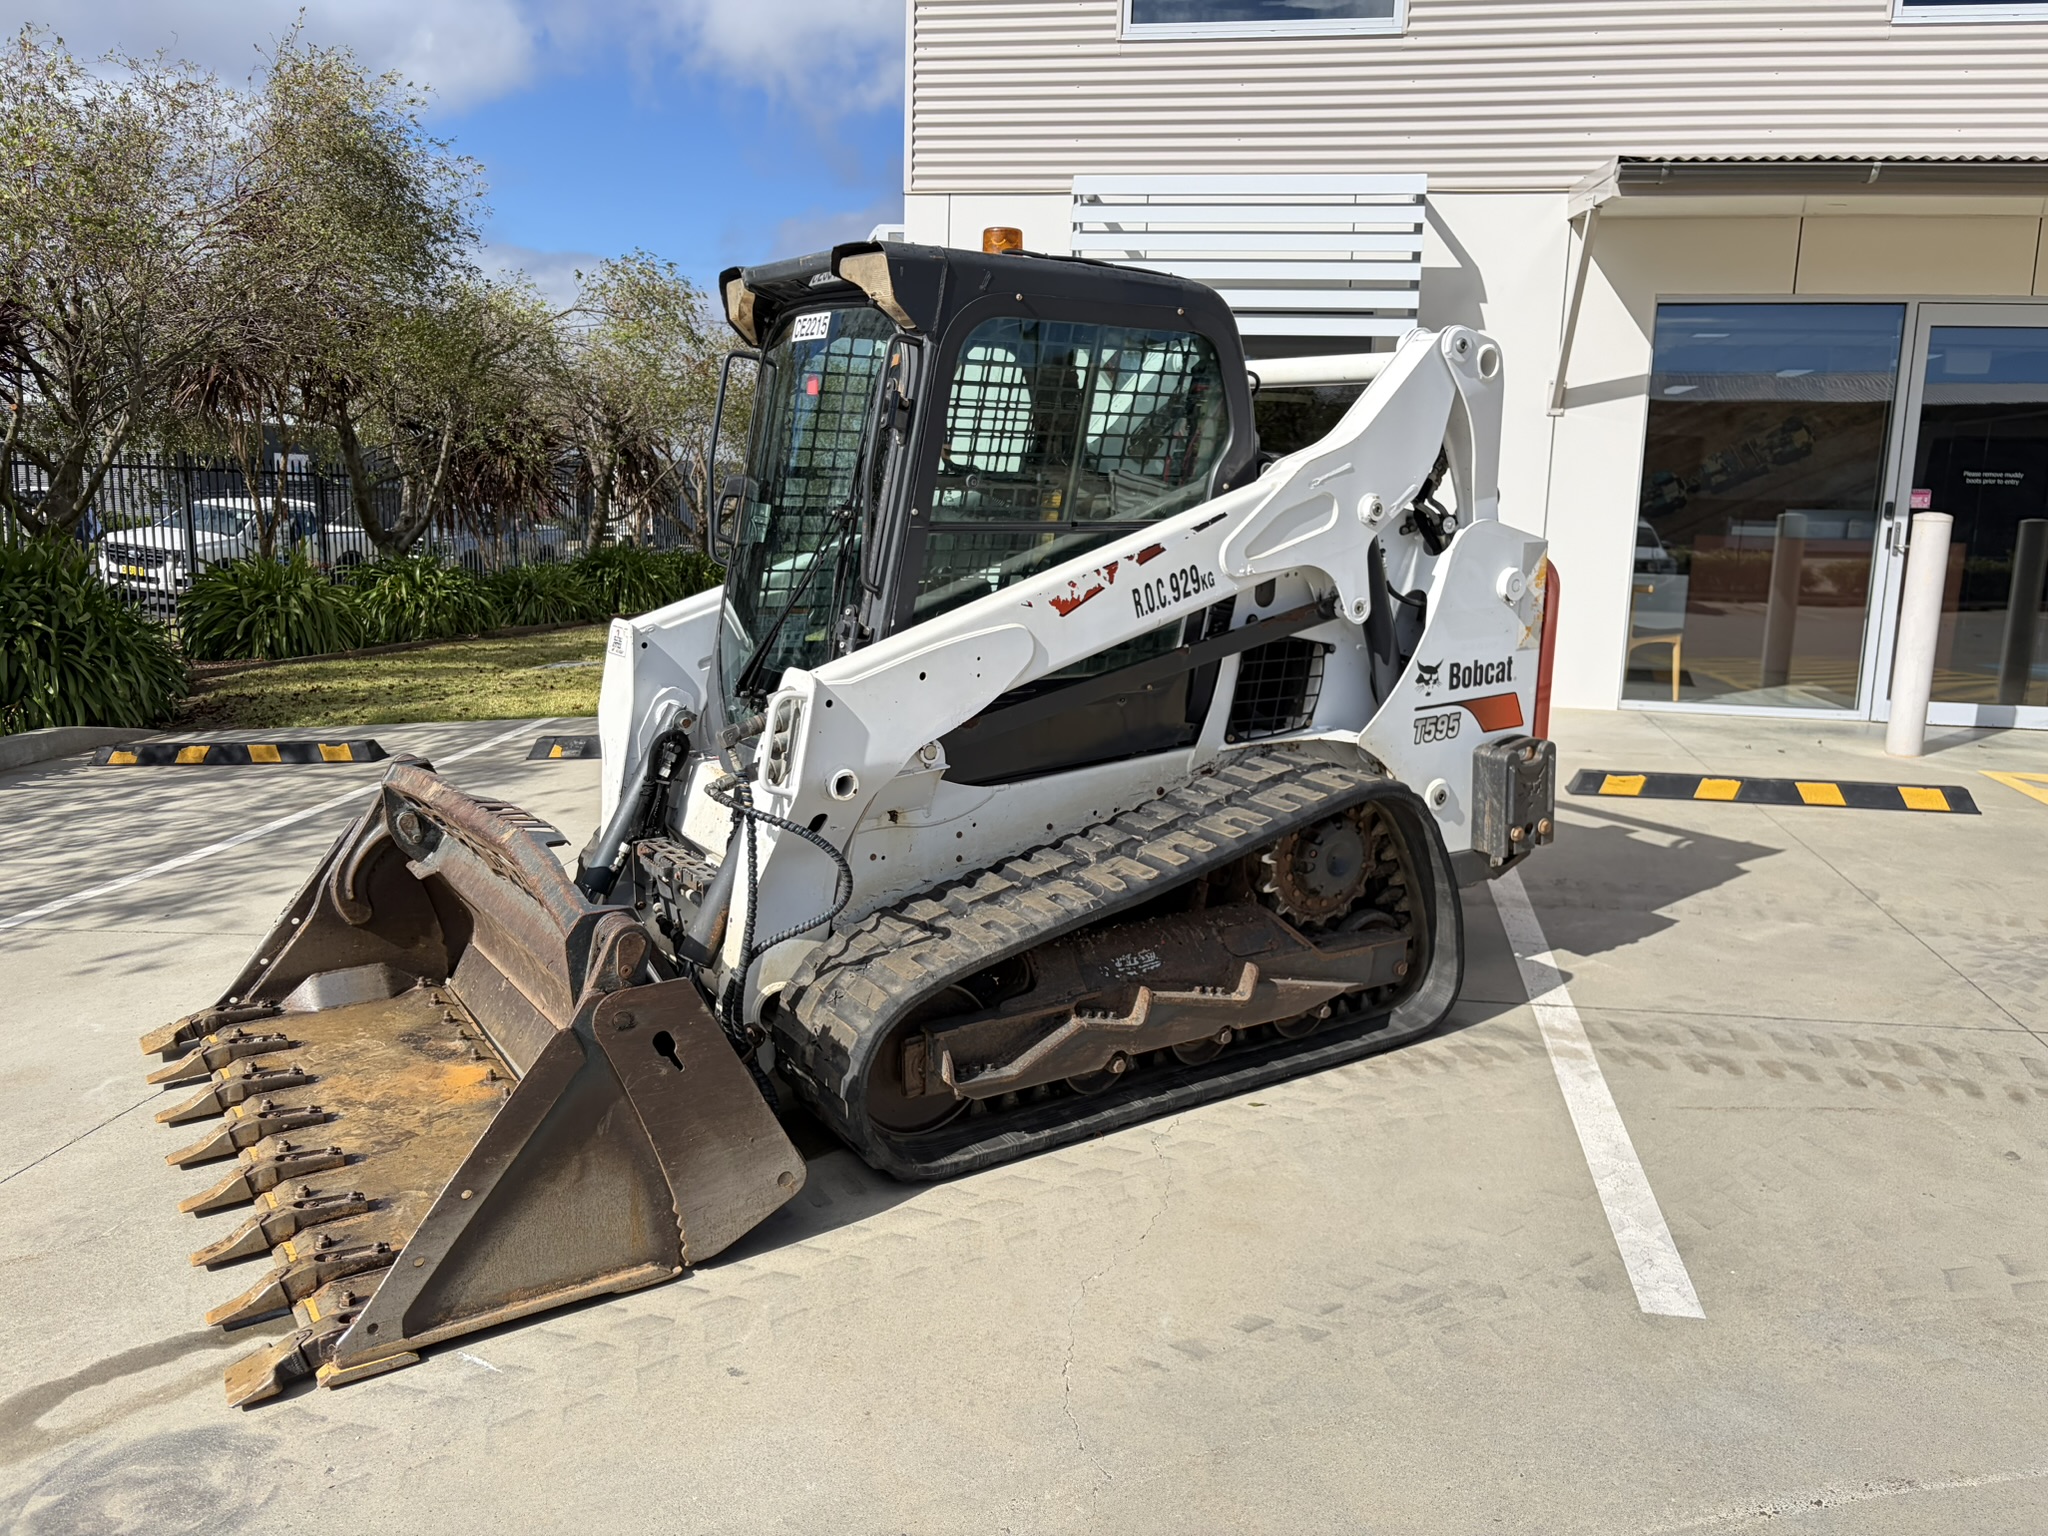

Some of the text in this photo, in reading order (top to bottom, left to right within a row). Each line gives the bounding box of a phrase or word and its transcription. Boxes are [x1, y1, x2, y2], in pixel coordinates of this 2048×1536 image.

[795, 315, 829, 339] CE2215
[1448, 656, 1513, 691] Bobcat
[1413, 711, 1461, 745] T595
